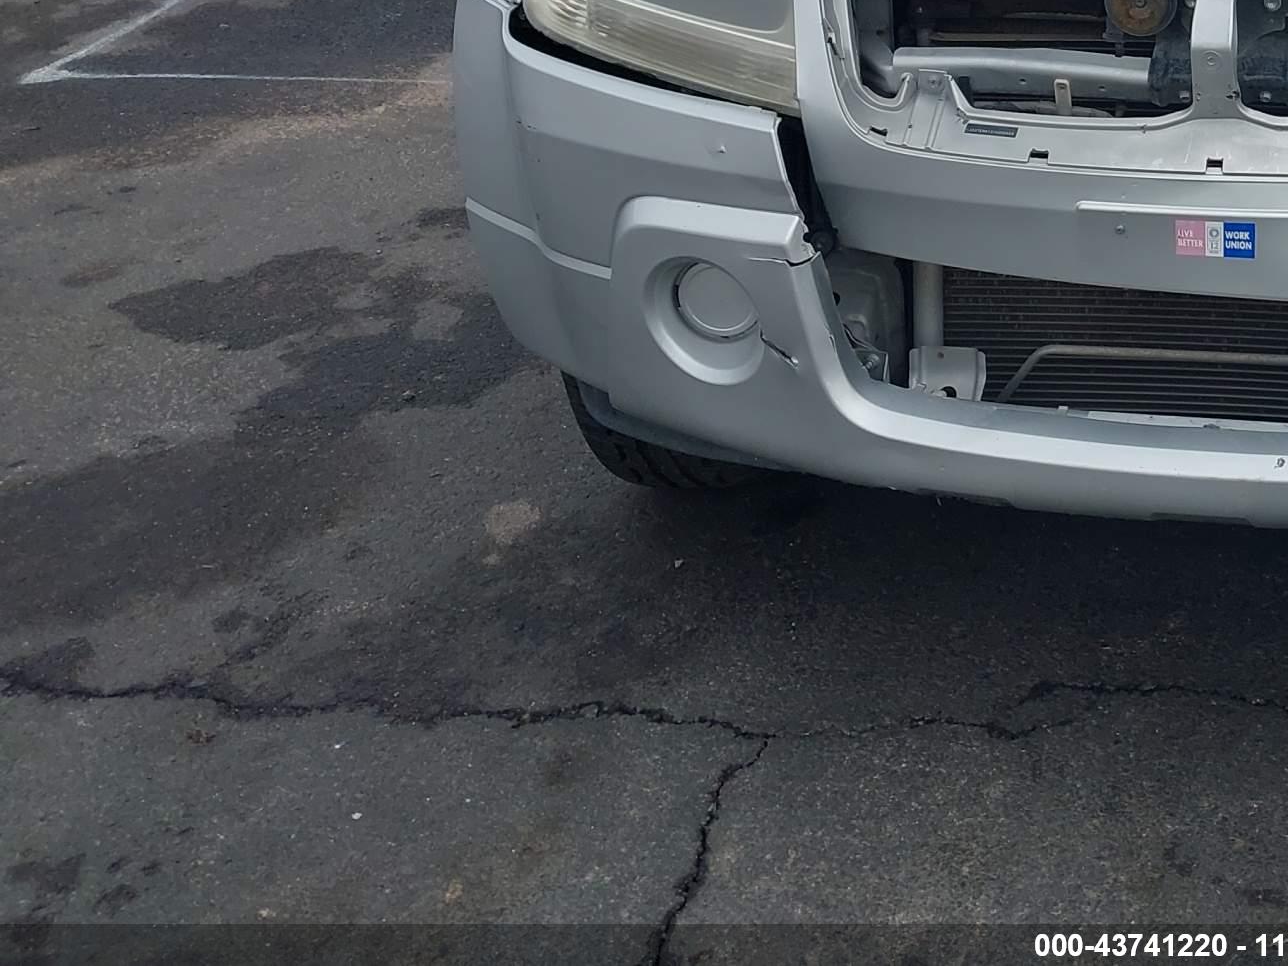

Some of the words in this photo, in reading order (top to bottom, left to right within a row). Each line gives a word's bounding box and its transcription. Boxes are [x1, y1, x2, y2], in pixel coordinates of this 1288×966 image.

[1177, 229, 1193, 237] LIVE
[1225, 231, 1250, 240] WORK
[1177, 238, 1203, 247] BETTER
[1225, 241, 1252, 250] UNION
